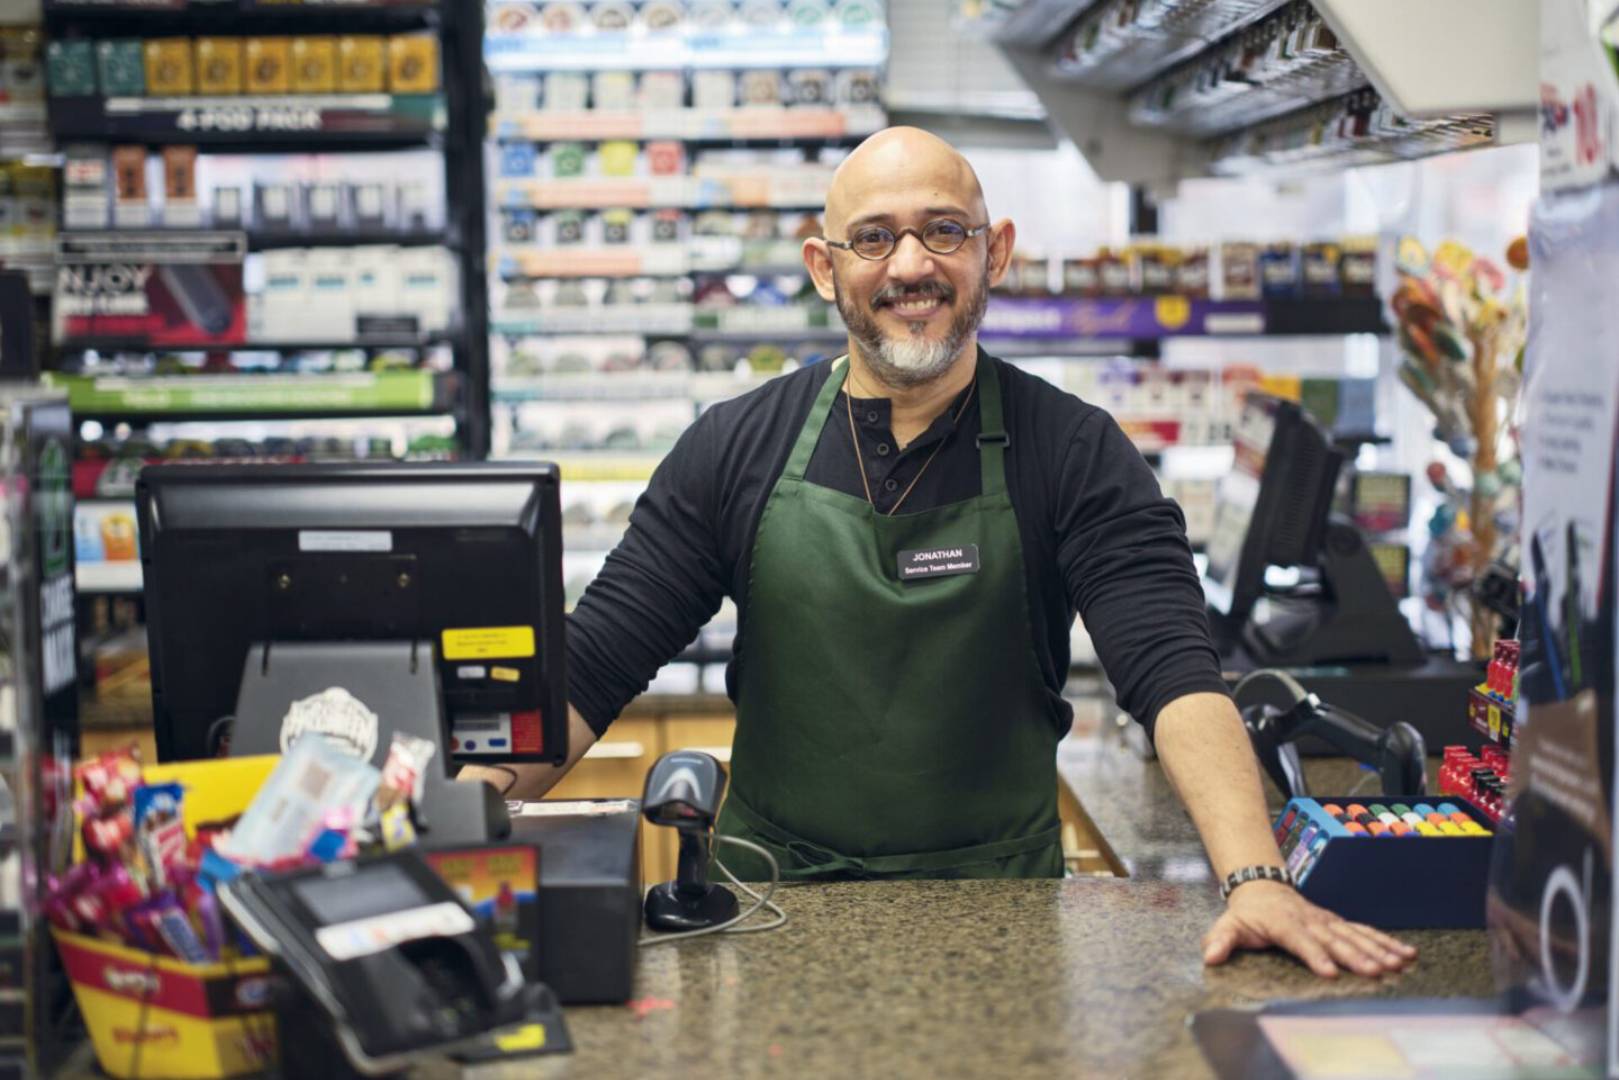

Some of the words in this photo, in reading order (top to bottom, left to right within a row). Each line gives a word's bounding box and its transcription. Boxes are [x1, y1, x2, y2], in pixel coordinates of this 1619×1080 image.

[257, 110, 322, 130] PACK
[58, 264, 152, 295] NJOY
[913, 549, 962, 561] JONATHAN
[905, 566, 928, 574] Service
[930, 564, 945, 572] Team
[946, 561, 972, 570] Member
